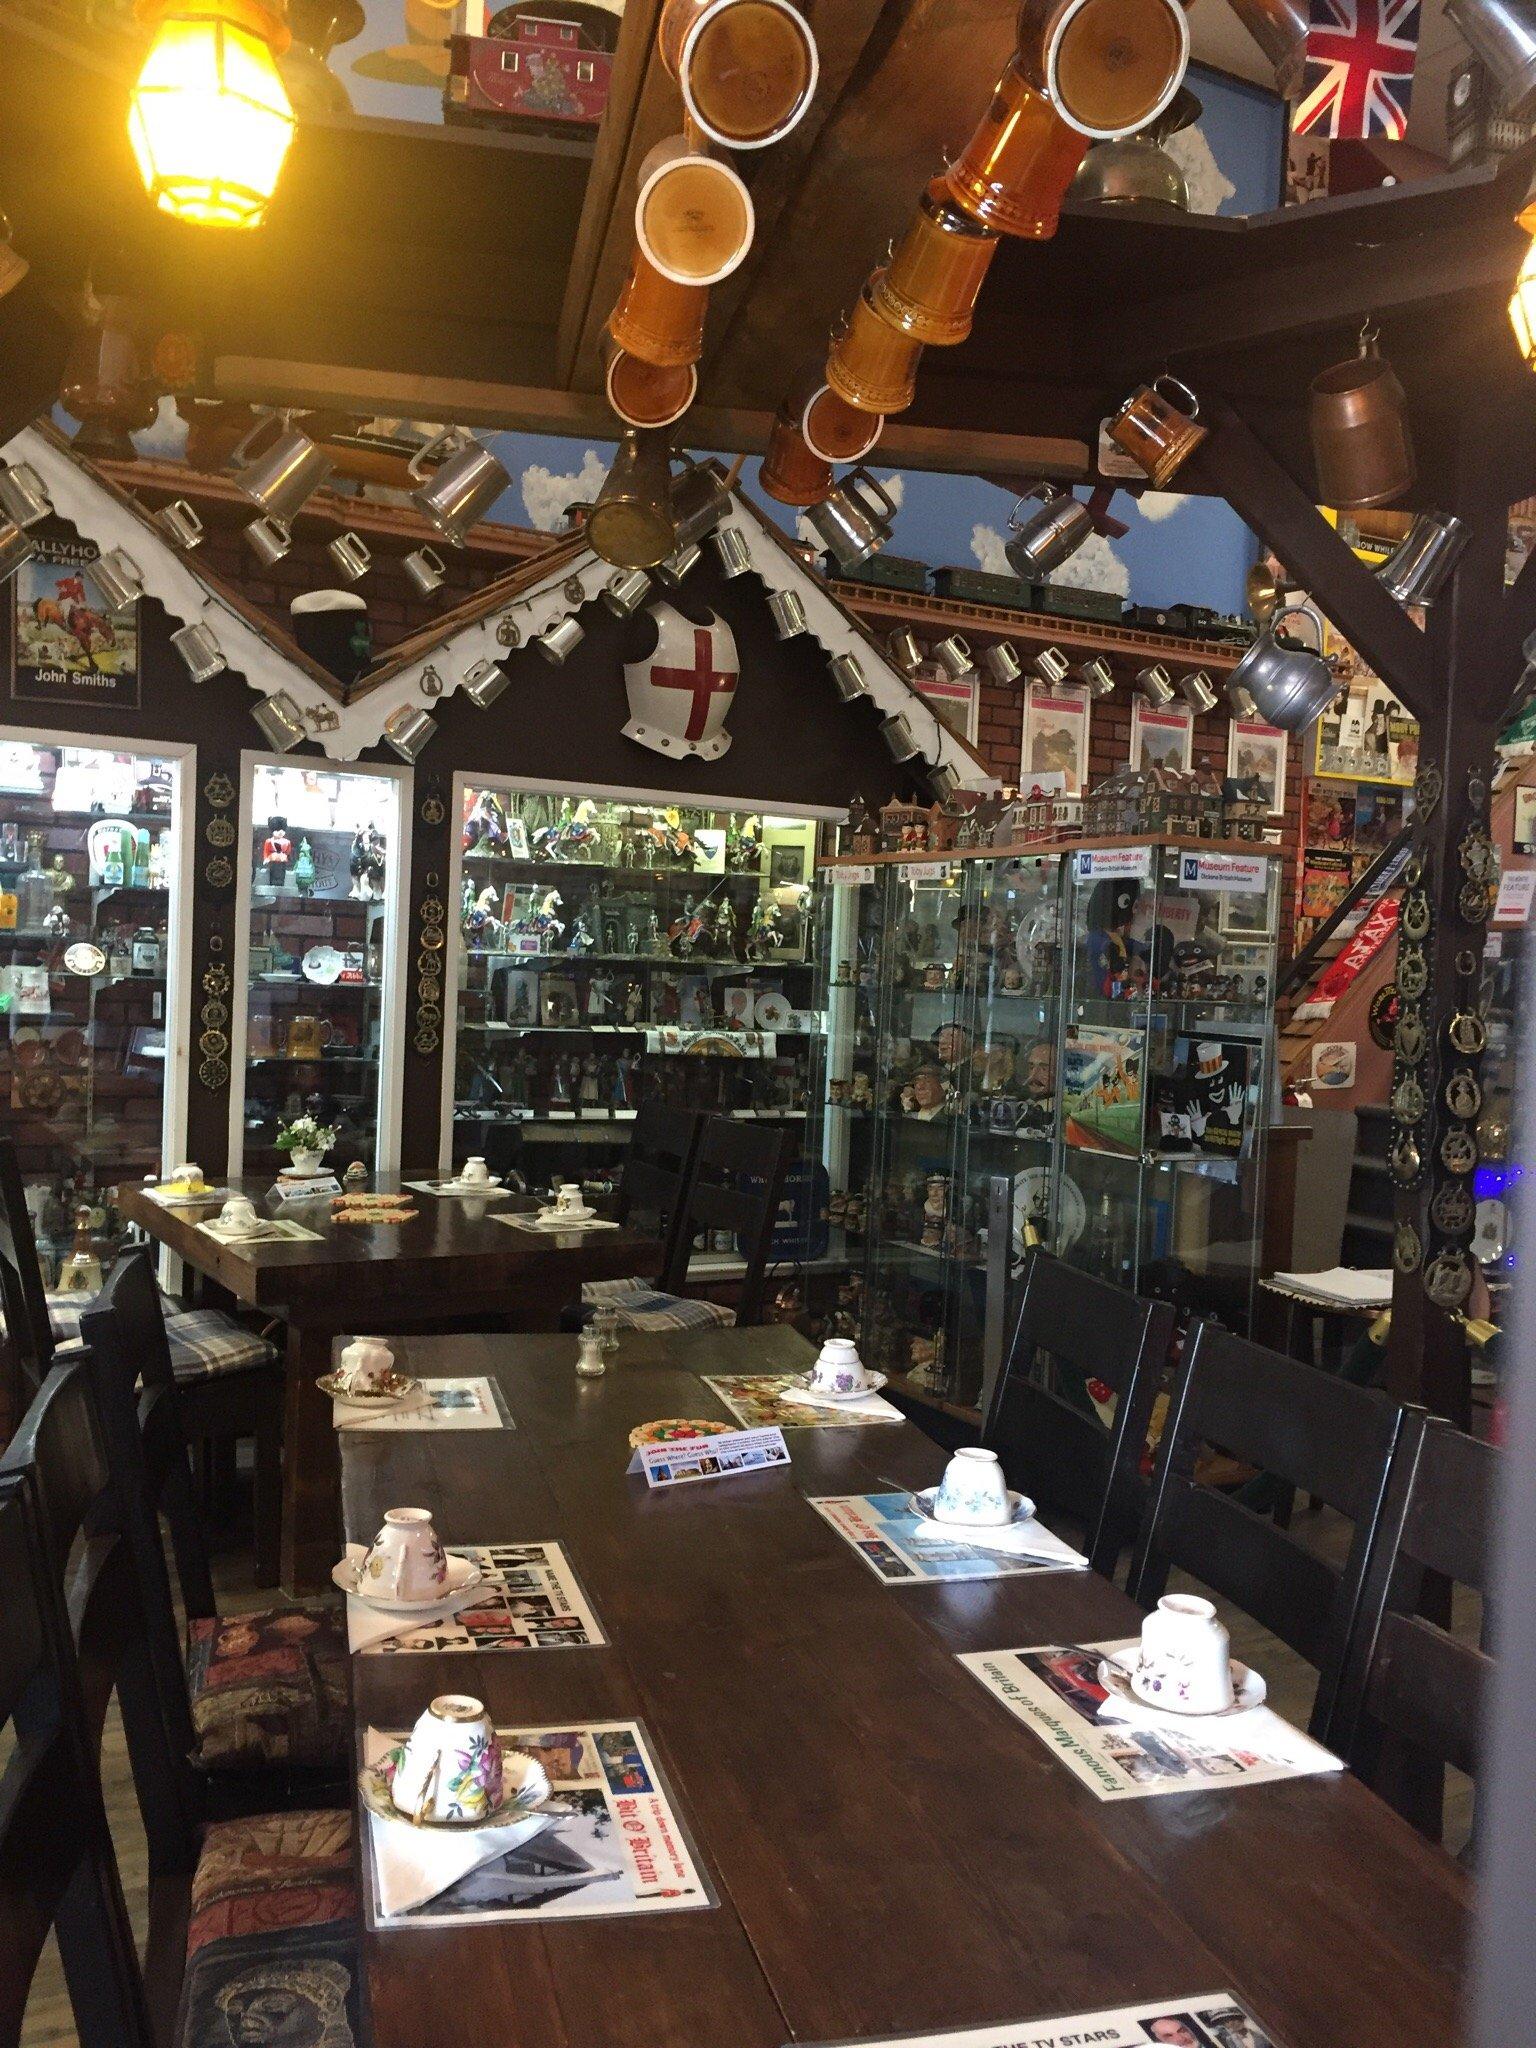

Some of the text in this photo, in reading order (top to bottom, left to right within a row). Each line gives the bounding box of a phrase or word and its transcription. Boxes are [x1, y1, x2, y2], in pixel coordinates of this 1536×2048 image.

[31, 539, 98, 559] ALLYHO
[35, 669, 117, 688] John Smiths
[1092, 854, 1118, 863] Museum
[1119, 852, 1144, 862] Feature
[1199, 860, 1230, 871] Museum
[1231, 862, 1260, 873] Feature
[647, 1446, 667, 1456] JOIN
[689, 1443, 709, 1451] FUN
[648, 1456, 666, 1464] Guess
[687, 1451, 705, 1459] Guess
[982, 1662, 1125, 1793] Famous Marques of Britain
[651, 1804, 662, 1816] trip
[655, 1816, 668, 1834] down
[616, 1799, 638, 1819] Bit
[629, 1836, 659, 1884] Britain
[662, 1834, 679, 1861] memory
[674, 1861, 686, 1878] lane
[1031, 2038, 1056, 2048] TV
[1059, 2028, 1121, 2047] STARS
